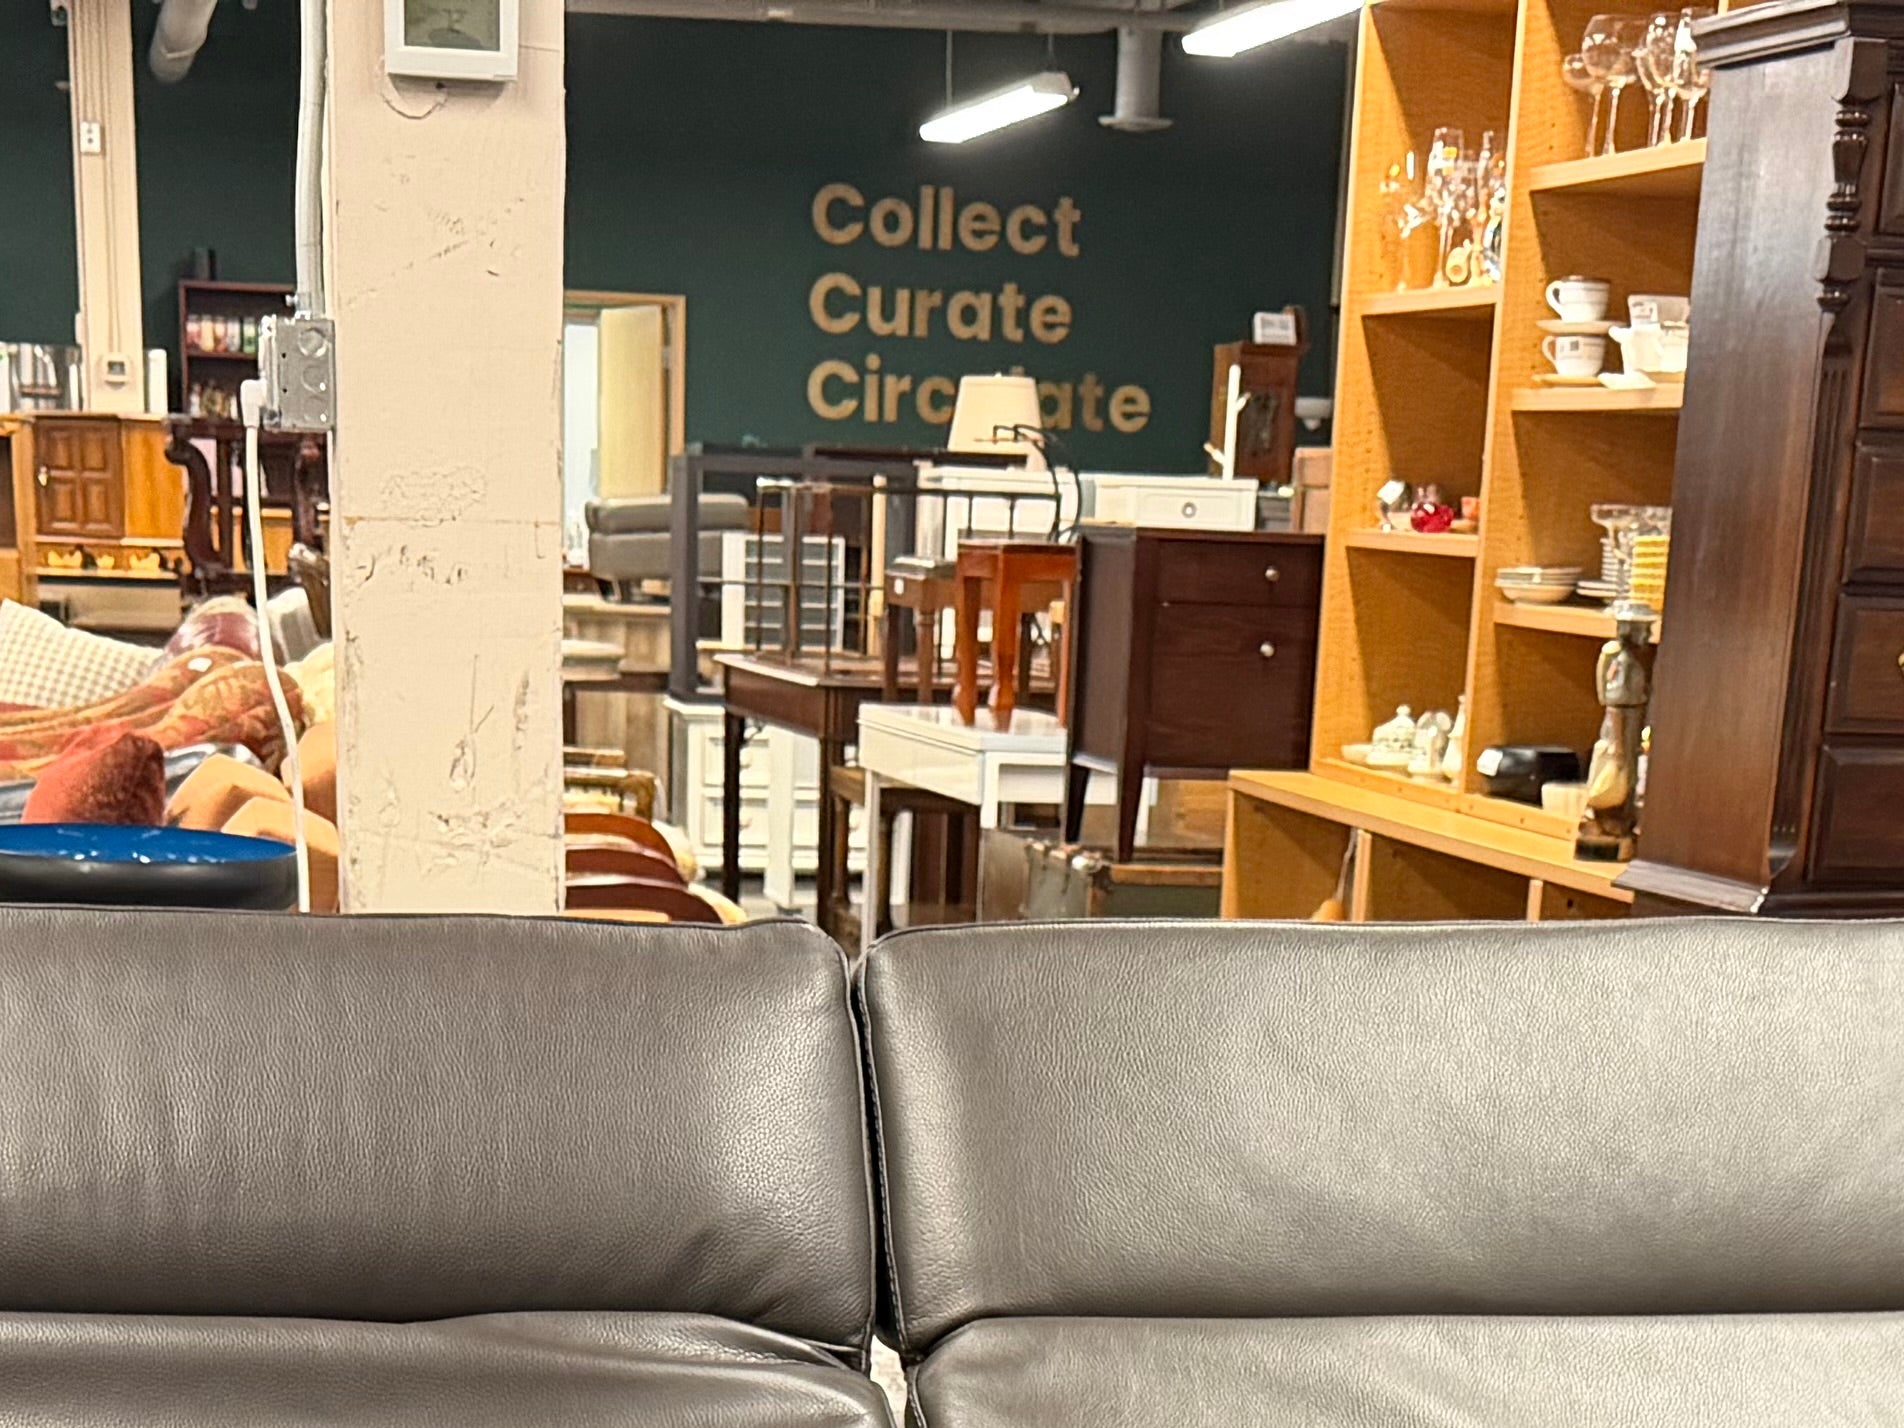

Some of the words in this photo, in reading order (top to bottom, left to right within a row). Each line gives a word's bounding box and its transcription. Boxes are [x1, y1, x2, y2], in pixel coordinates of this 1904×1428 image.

[811, 183, 1081, 257] Collect
[809, 271, 1072, 343] Curate
[807, 353, 1151, 433] Circate
